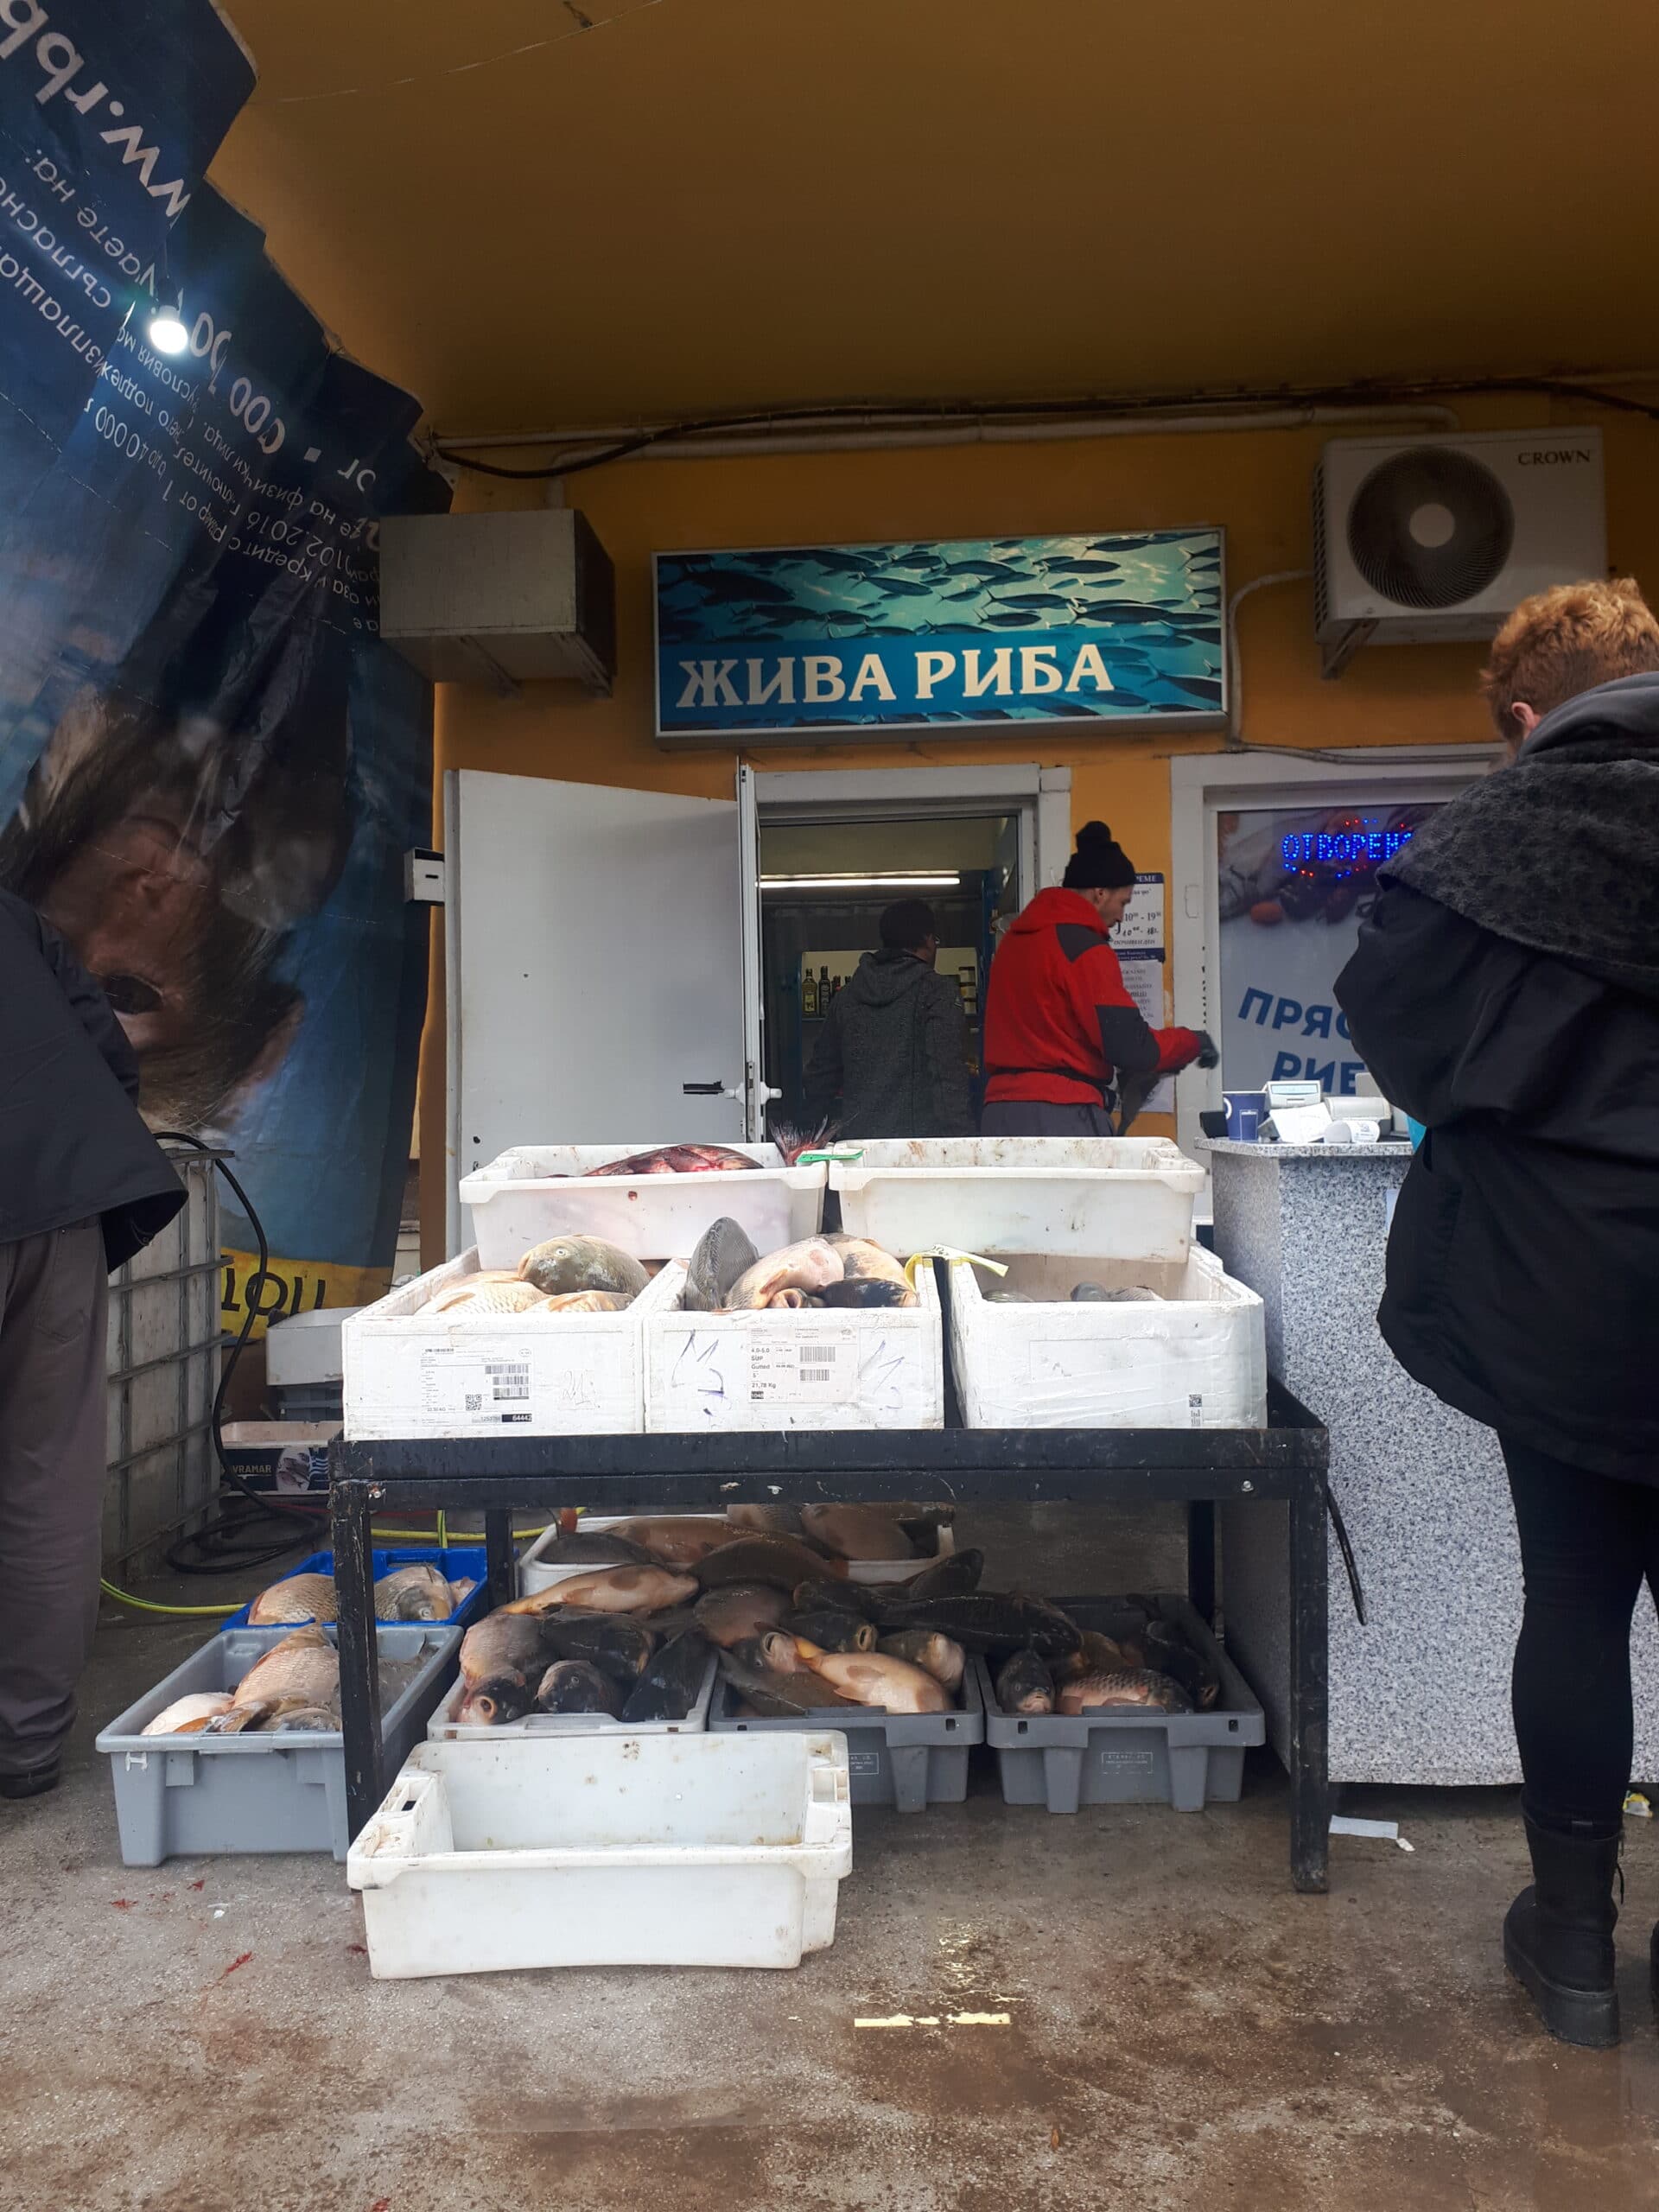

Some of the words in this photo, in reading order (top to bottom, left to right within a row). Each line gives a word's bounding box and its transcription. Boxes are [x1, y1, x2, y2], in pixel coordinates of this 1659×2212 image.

[1518, 450, 1591, 465] CROWN
[307, 500, 337, 525] на
[243, 541, 314, 582] кредит
[677, 653, 897, 708] ЖИВА
[914, 643, 1116, 700] РИБА
[1271, 1051, 1365, 1095] РИБ
[228, 1465, 271, 1473] VRAMAR
